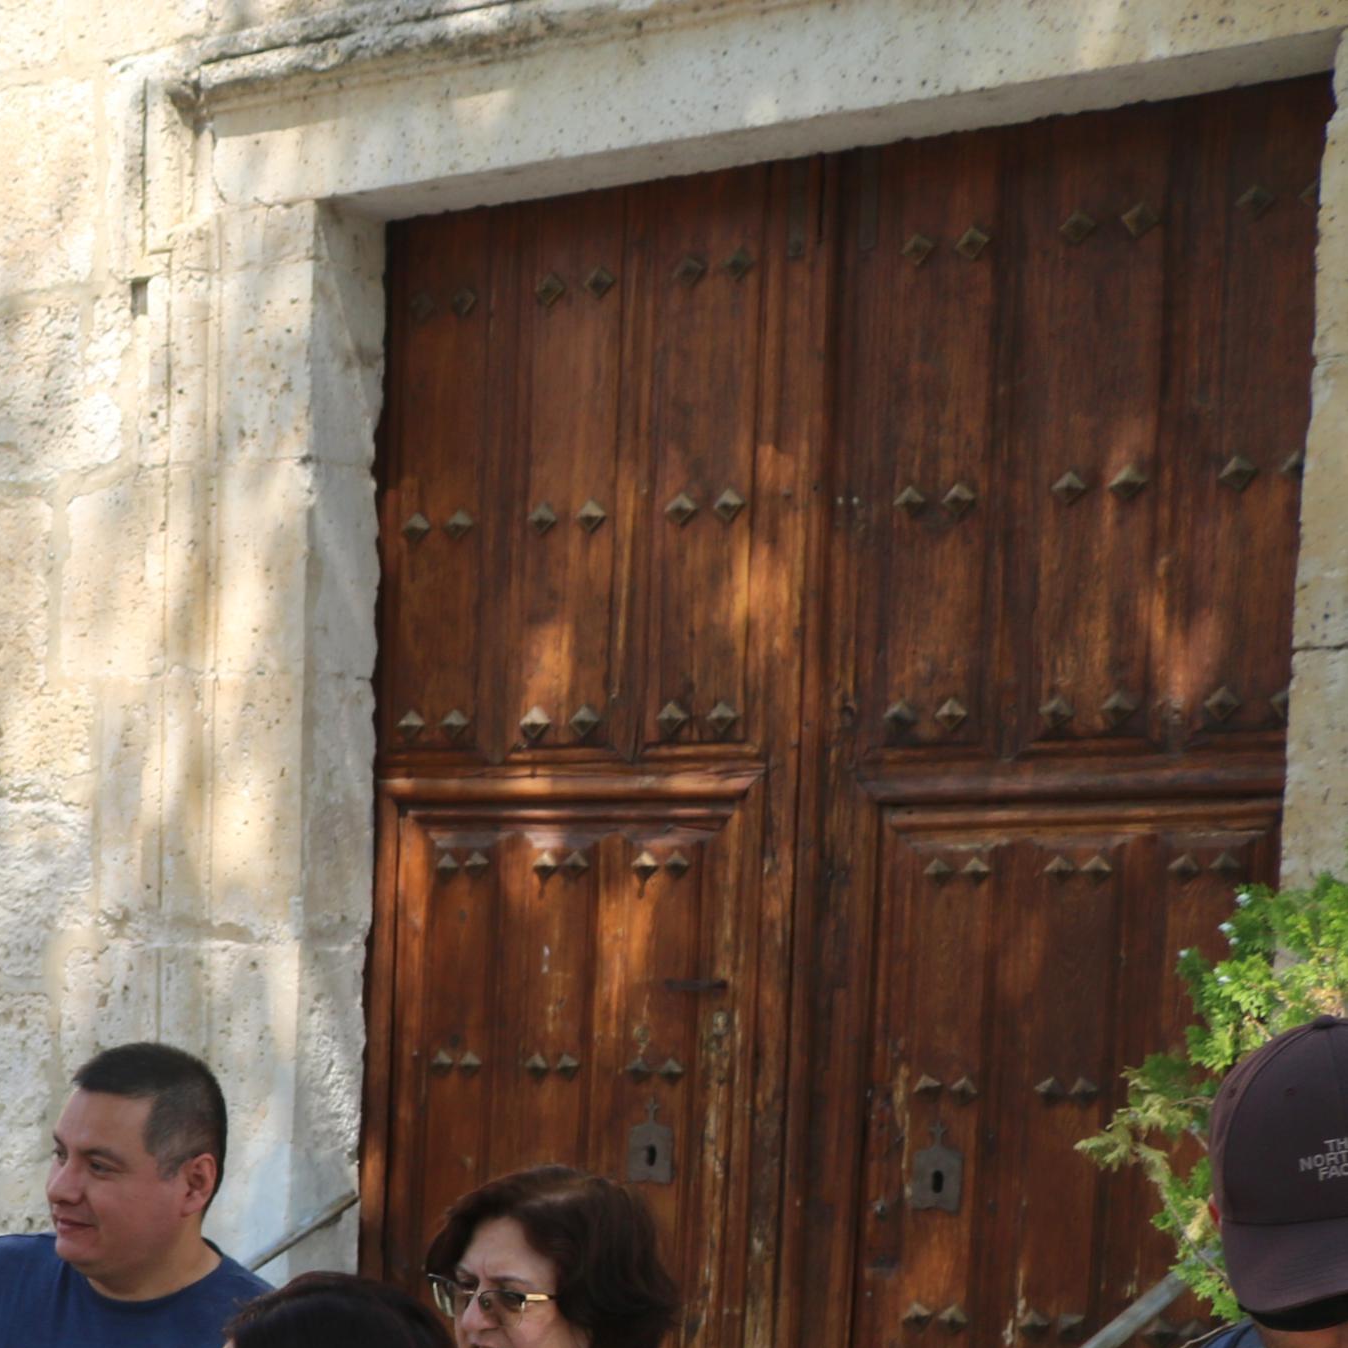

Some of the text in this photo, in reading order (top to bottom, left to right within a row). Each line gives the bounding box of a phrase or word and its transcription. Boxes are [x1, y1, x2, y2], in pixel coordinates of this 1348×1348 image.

[1323, 1137, 1348, 1153] TH
[1299, 1150, 1348, 1173] NORT
[1319, 1163, 1348, 1182] FAC
